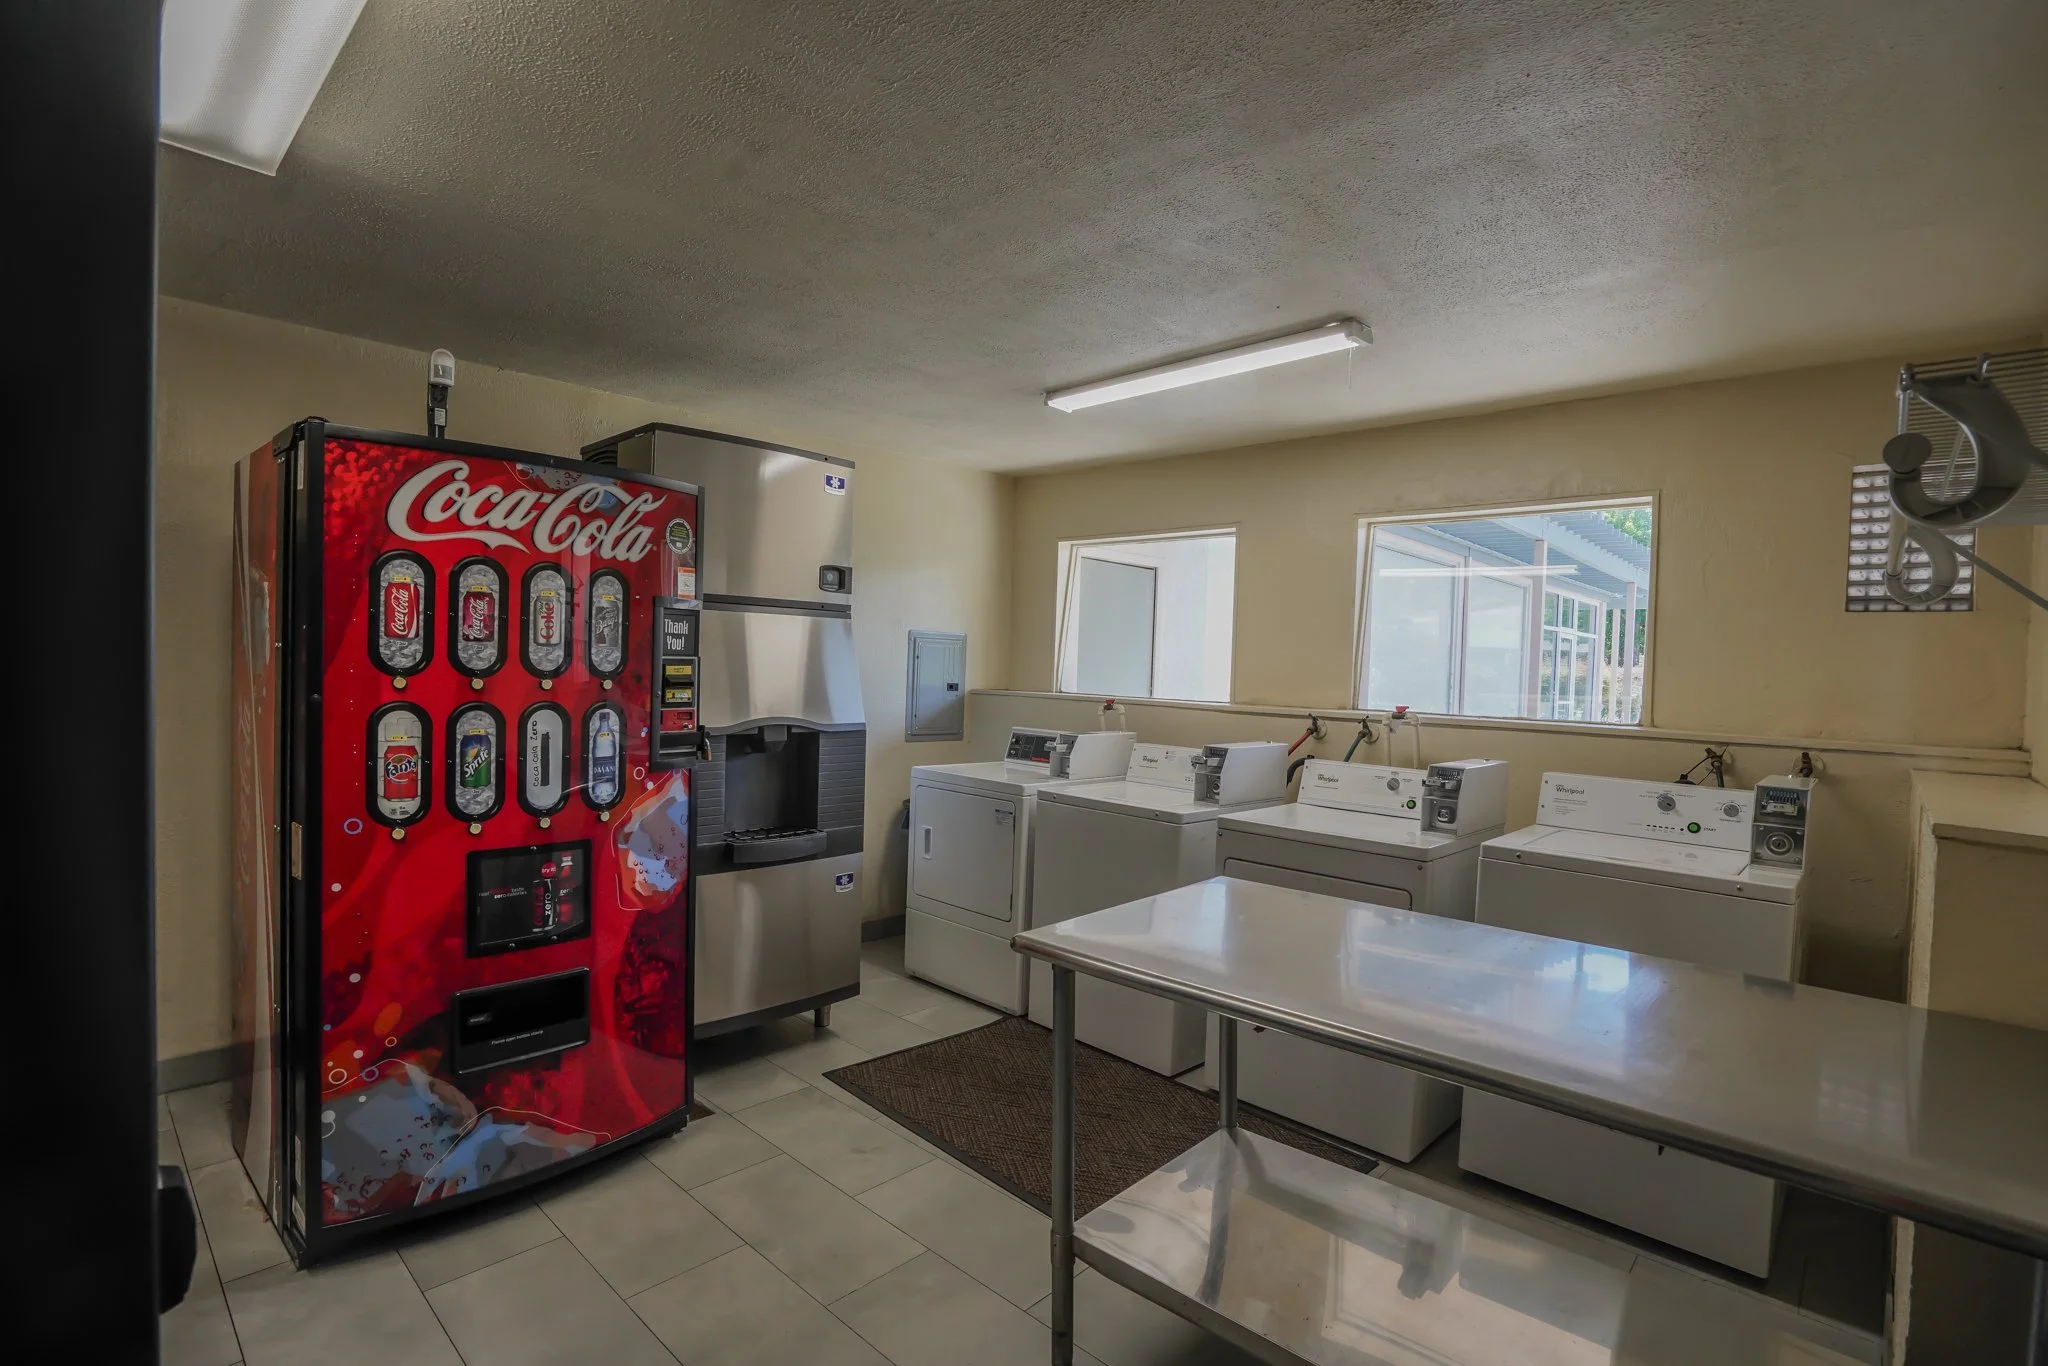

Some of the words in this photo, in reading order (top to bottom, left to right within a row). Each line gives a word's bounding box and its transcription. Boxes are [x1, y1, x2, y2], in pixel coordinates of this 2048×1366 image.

[387, 459, 668, 562] Coca-Cola
[391, 587, 409, 635] Coca-Cola
[540, 602, 555, 640] Coke
[664, 618, 689, 635] Thank
[666, 635, 685, 651] You!
[385, 758, 418, 778] Fanta
[463, 746, 490, 778] Sprite
[1317, 773, 1340, 783] Whirlpool
[1555, 785, 1585, 796] Whirlpool
